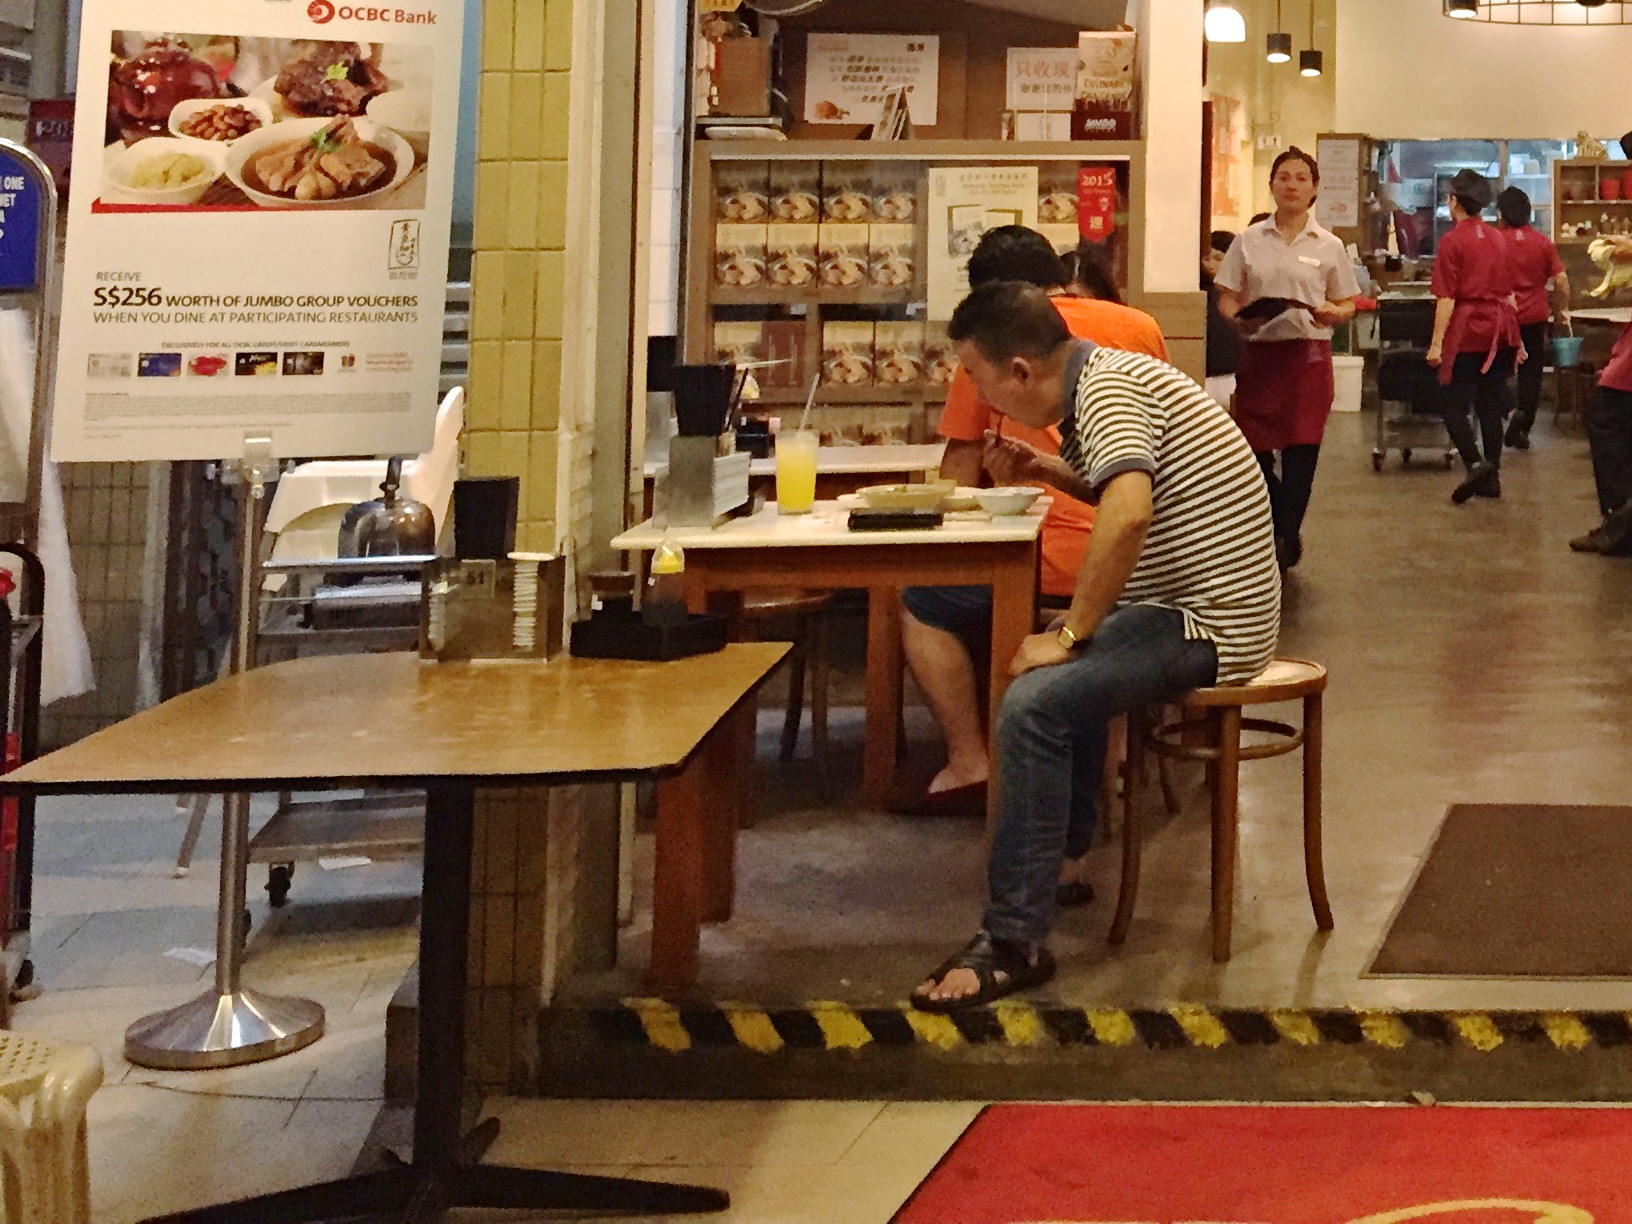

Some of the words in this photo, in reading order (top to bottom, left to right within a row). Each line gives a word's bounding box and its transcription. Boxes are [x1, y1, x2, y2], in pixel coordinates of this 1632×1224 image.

[338, 6, 391, 22] OCBC
[394, 9, 438, 24] Bank
[4, 176, 25, 190] ONE
[1081, 172, 1114, 187] 2015
[96, 271, 142, 281] RECEIVE
[93, 285, 162, 308] S$256
[165, 295, 220, 307] WORTH
[223, 295, 241, 307] OF
[243, 295, 294, 308] JUMBO
[296, 295, 345, 307] GROUP
[347, 295, 418, 307] VOUCHERS
[93, 312, 138, 323] WHEN
[141, 312, 171, 323] YOU
[174, 312, 206, 323] DINE
[209, 312, 225, 323] AT
[229, 311, 326, 323] PARTICIPATING
[328, 311, 418, 323] RESTAURANTS
